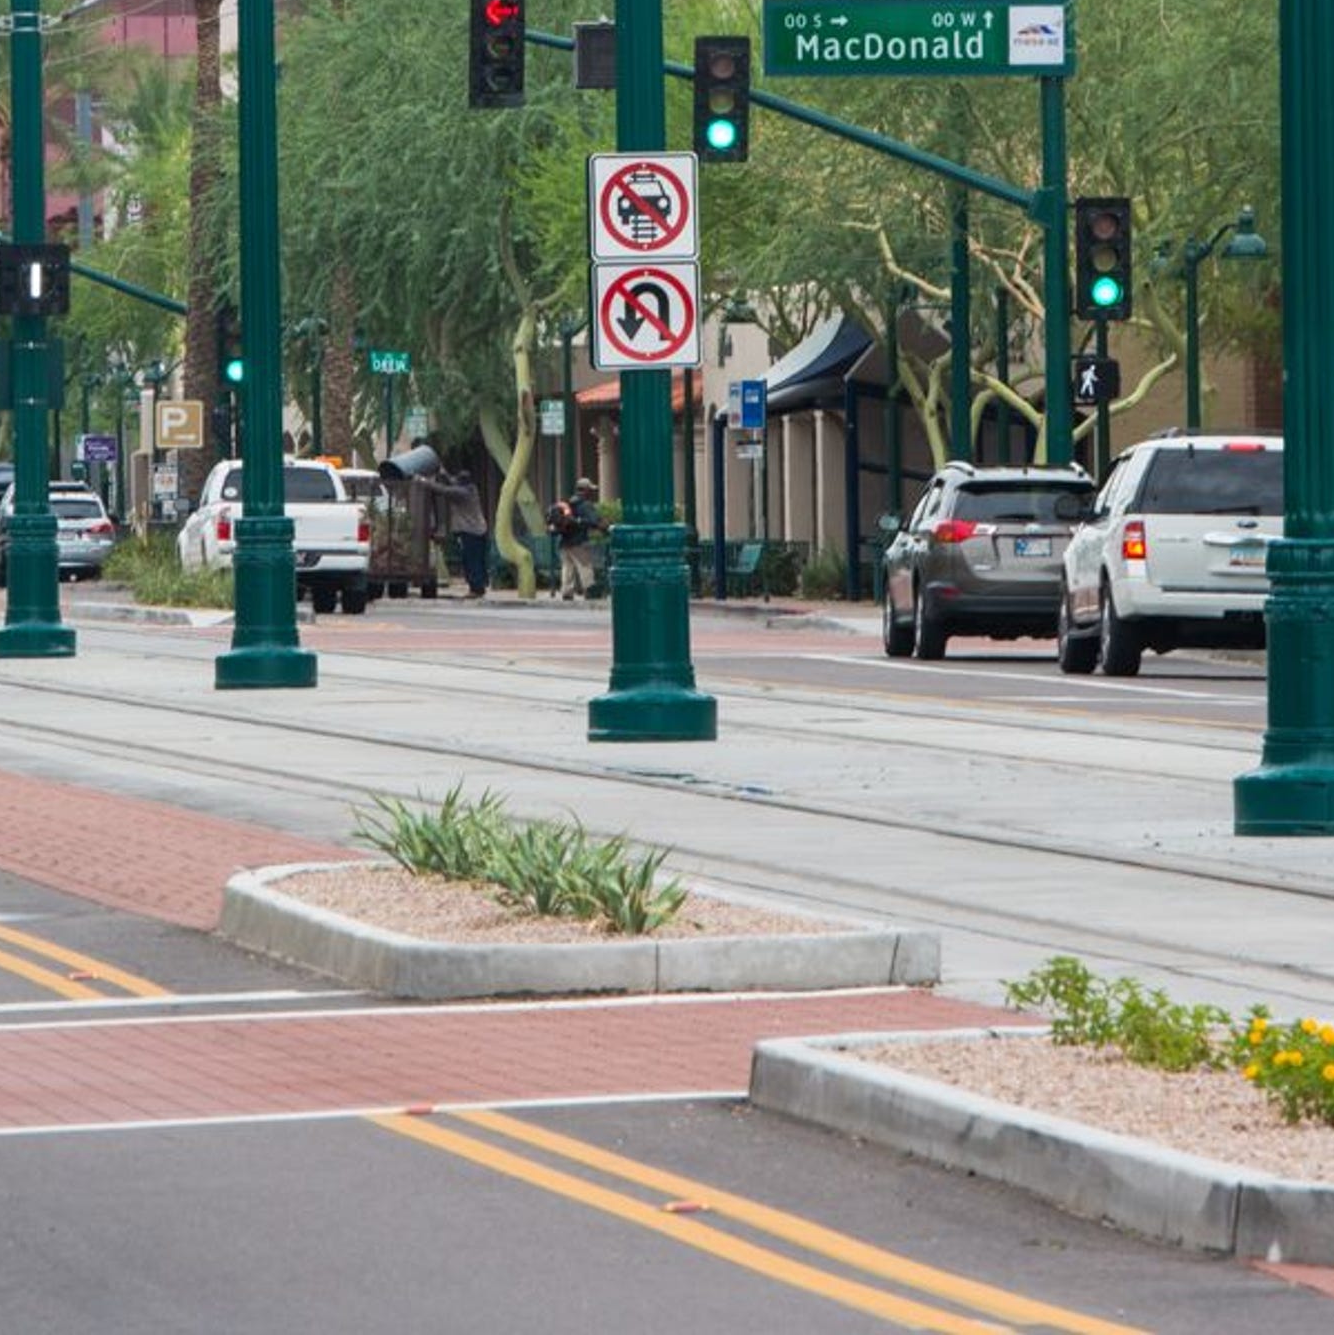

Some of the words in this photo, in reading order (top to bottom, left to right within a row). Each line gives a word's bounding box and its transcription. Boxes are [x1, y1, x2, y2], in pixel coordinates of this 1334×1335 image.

[784, 13, 807, 29] 00
[813, 13, 822, 29] S
[931, 11, 955, 27] 00
[961, 11, 977, 26] W
[796, 30, 984, 61] MacDonald
